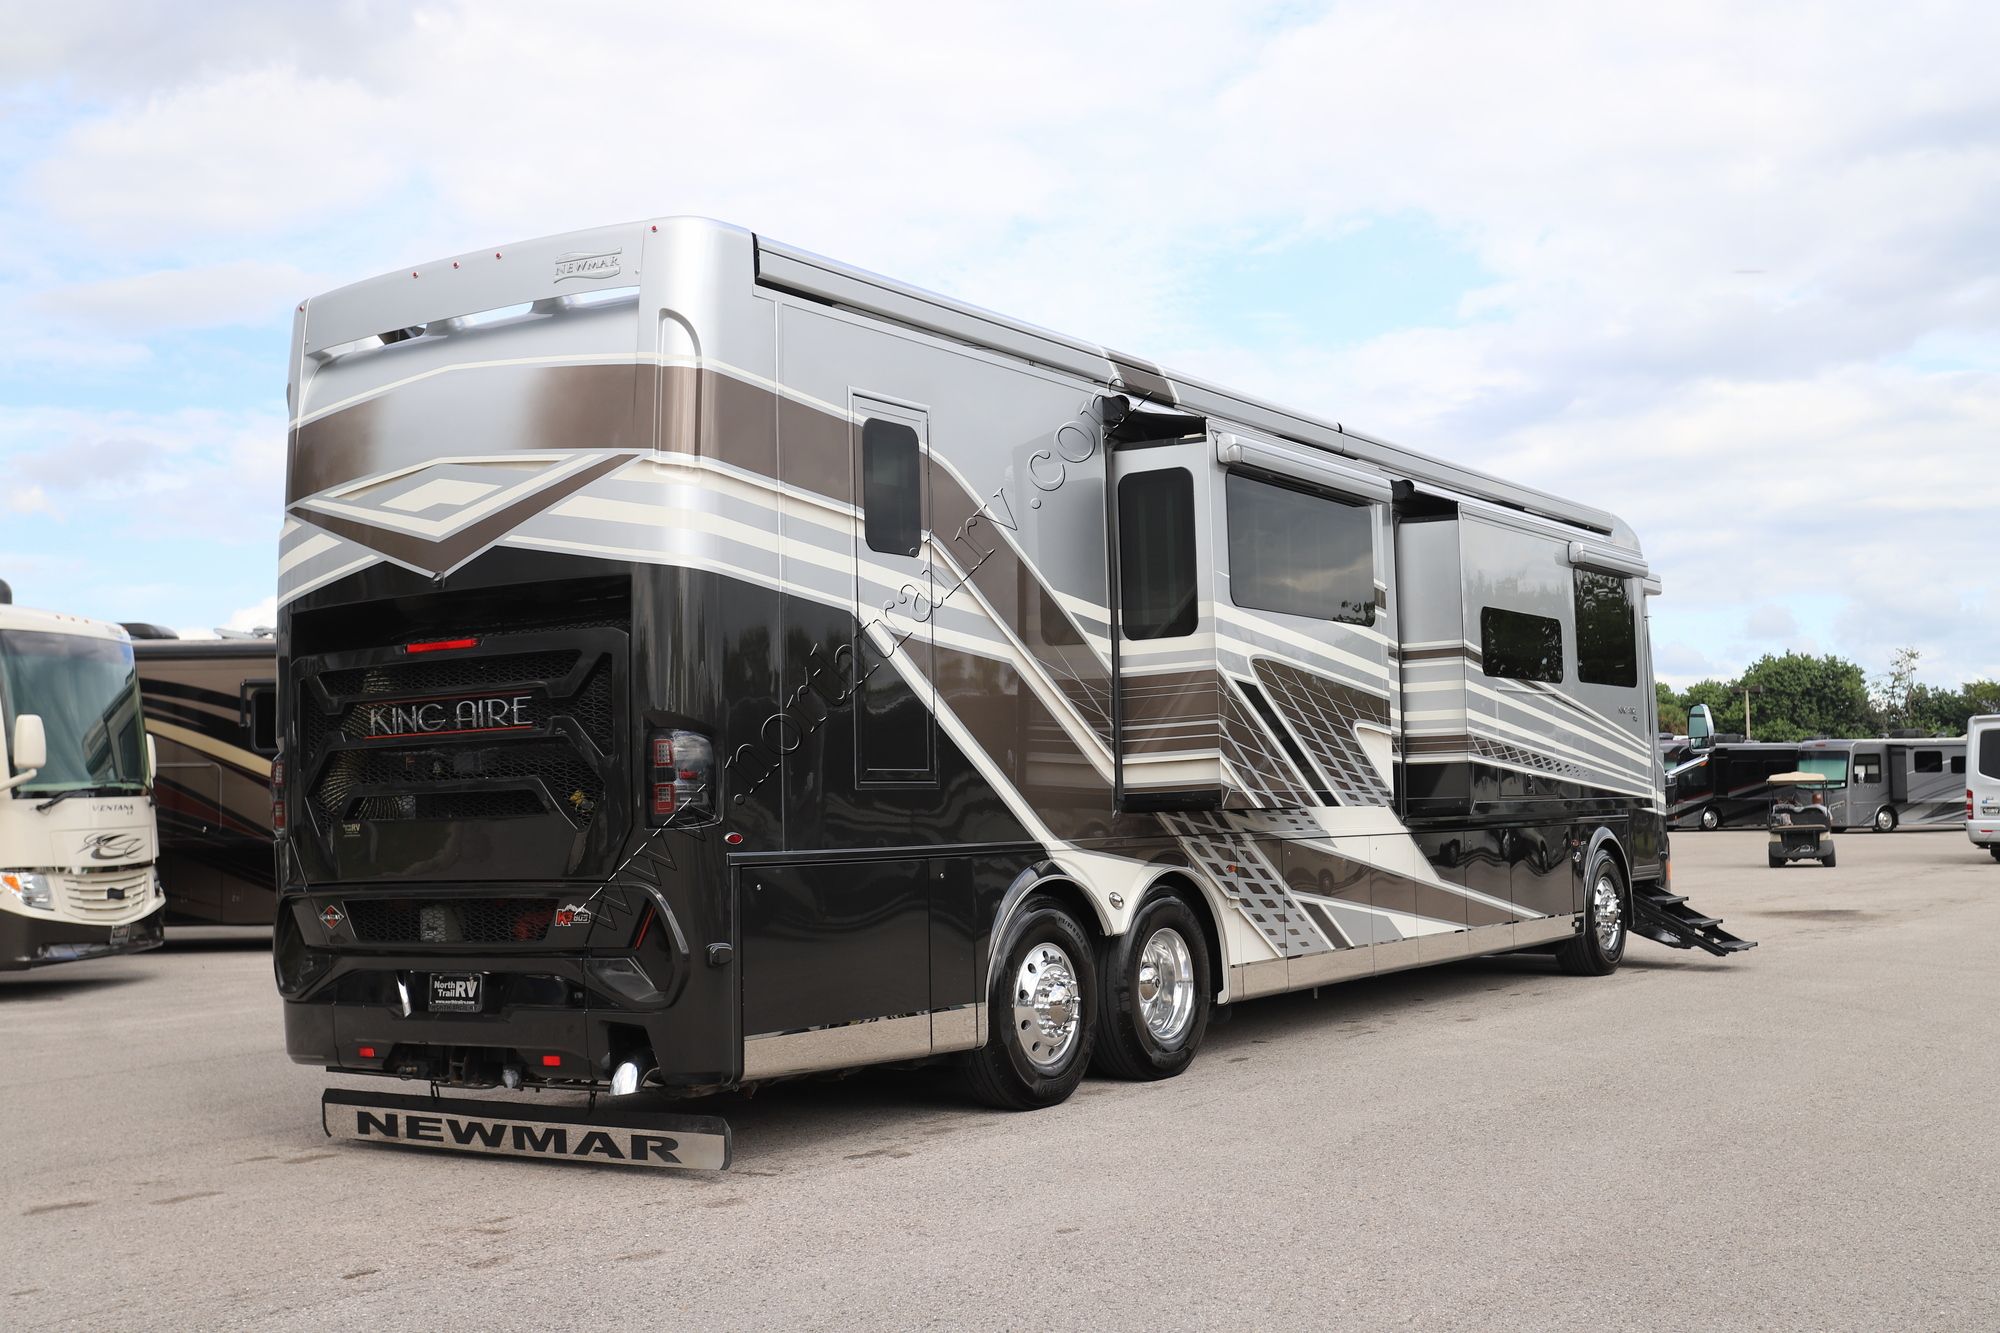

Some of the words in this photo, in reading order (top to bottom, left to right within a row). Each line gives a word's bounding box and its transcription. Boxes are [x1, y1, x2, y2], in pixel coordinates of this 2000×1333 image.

[555, 256, 620, 276] NEWMAR
[370, 703, 446, 736] KING
[453, 696, 533, 730] AIRE
[92, 804, 134, 812] VENTANA
[434, 980, 456, 989] North
[437, 989, 456, 997] Trail
[455, 980, 478, 998] RV
[356, 1110, 683, 1164] NEWMAR
